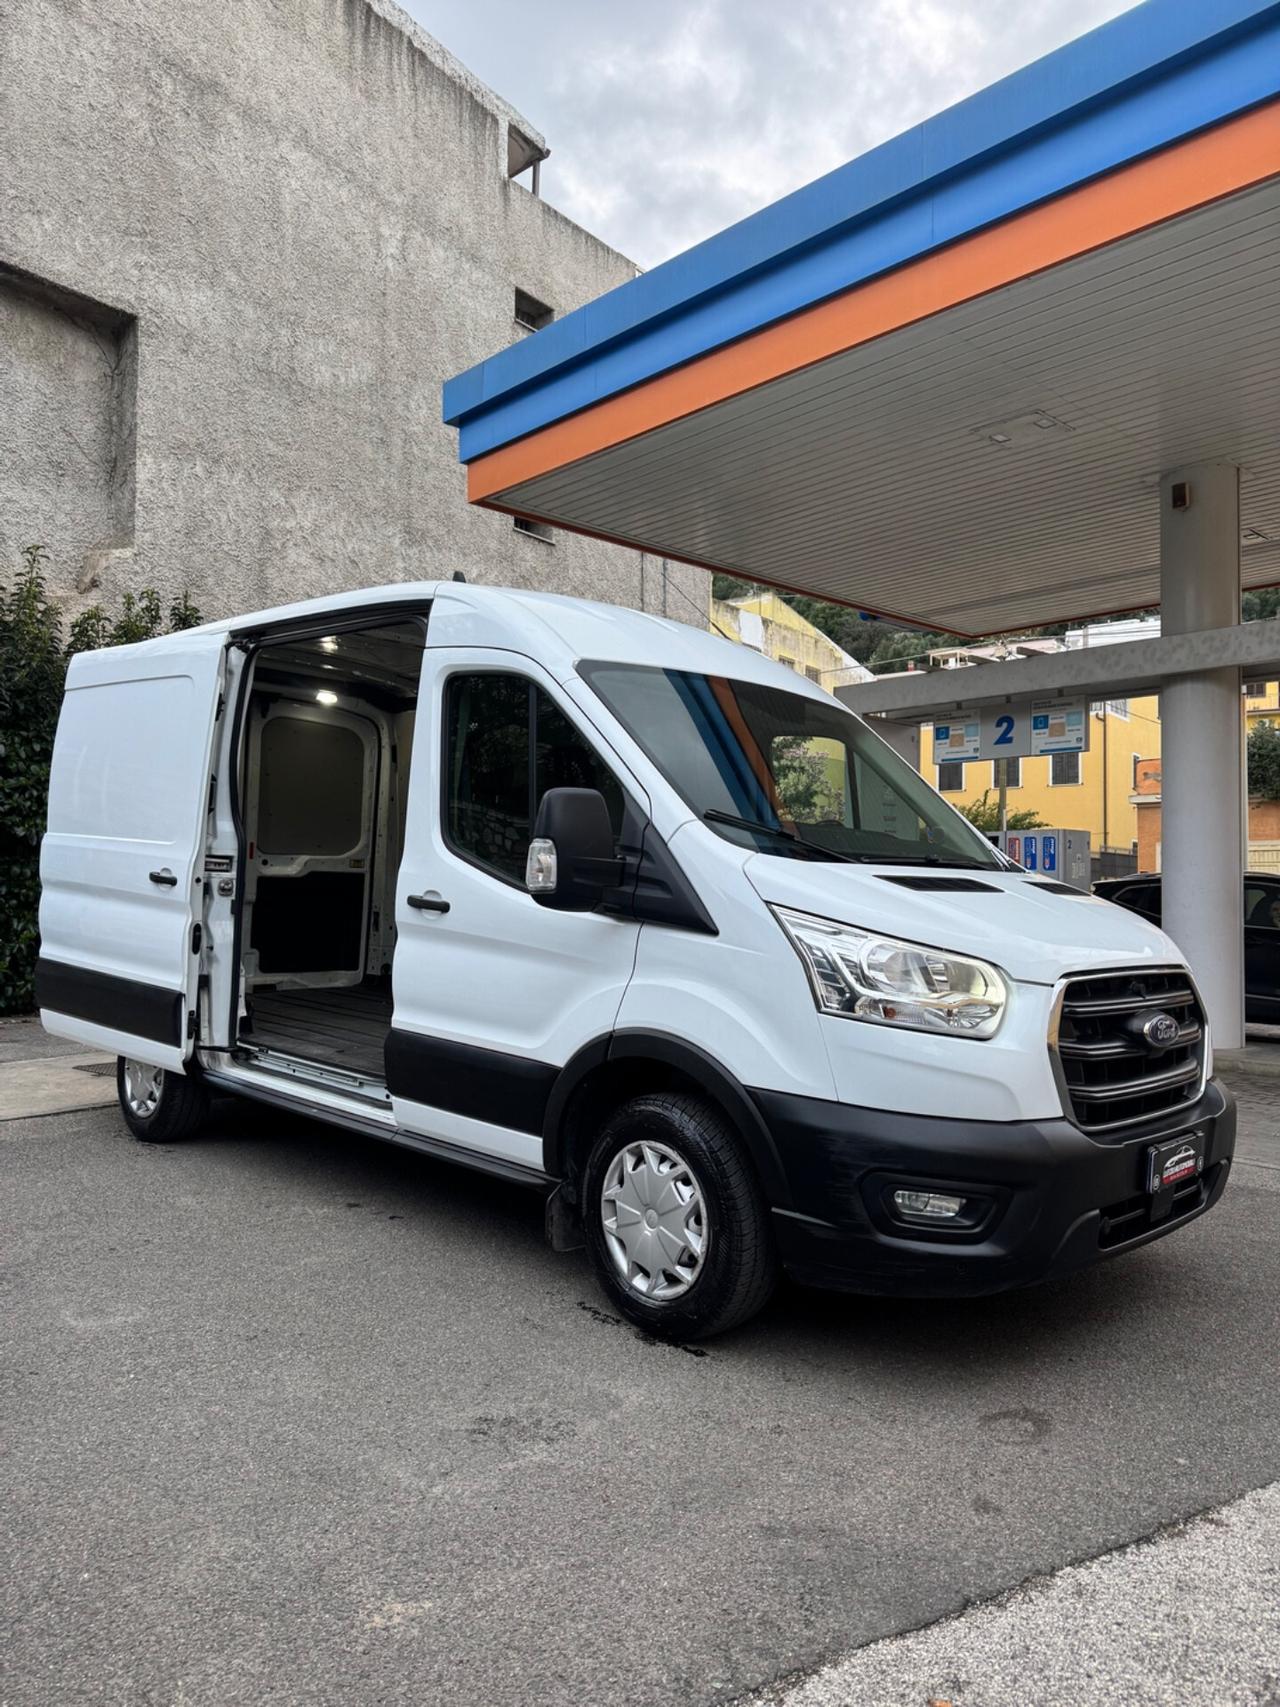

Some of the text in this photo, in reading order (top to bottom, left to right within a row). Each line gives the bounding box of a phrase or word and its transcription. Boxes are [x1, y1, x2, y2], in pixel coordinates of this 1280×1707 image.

[994, 716, 1015, 745] 2
[1067, 840, 1072, 849] 2
[1157, 1019, 1176, 1040] Ford
